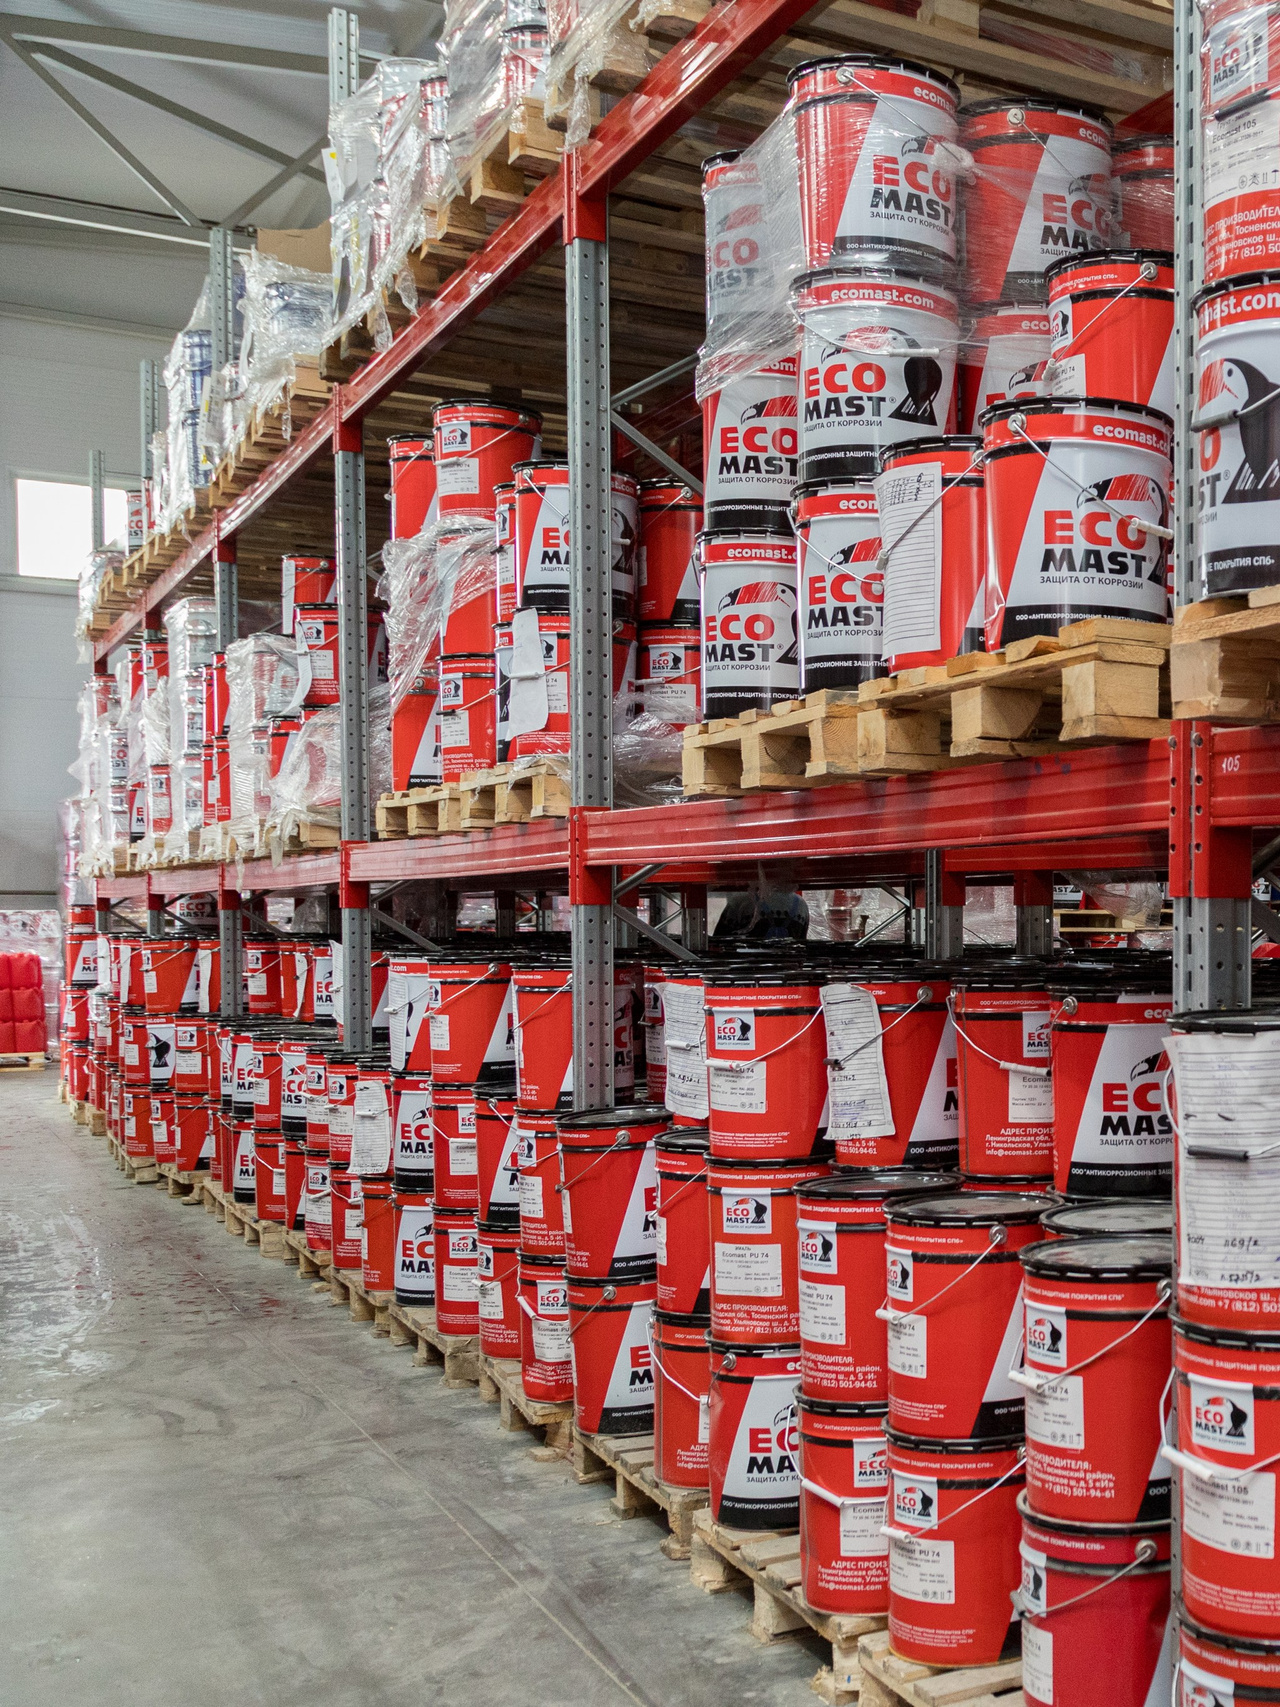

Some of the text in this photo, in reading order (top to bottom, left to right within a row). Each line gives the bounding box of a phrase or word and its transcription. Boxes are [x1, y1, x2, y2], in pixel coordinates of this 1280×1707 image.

[1213, 125, 1241, 144] Ecomast
[1243, 119, 1257, 130] 105
[873, 155, 951, 201] ECO
[870, 188, 952, 228] MAST
[1229, 250, 1239, 260] +7
[1241, 244, 1265, 259] (812)
[831, 287, 933, 309] ecomast.com
[804, 363, 886, 399] ECO
[804, 396, 886, 423] MAST
[720, 426, 798, 453] ECO
[1093, 424, 1171, 451] ecomast.co
[718, 456, 798, 476] MAST
[756, 477, 798, 485] КОРРОЗИИ
[1044, 510, 1147, 550] ECO
[1040, 549, 1147, 578] MAST
[1215, 557, 1251, 571] ПОКРЫТИЯ
[809, 574, 884, 605] ECO
[1040, 576, 1080, 584] ЗАЩИТА
[1099, 577, 1143, 589] КОРРОЗИИ
[705, 614, 774, 642] ECO
[807, 630, 831, 639] ЗАЩИТА
[705, 644, 774, 662] MAST
[1222, 755, 1240, 773] 105
[180, 903, 205, 911] ECO
[1232, 1301, 1259, 1313] (812)
[1215, 1360, 1256, 1371] ЗАЩИТНЫЕ
[839, 1380, 877, 1388] 501-94-61
[1059, 1387, 1069, 1395] 74
[1196, 1406, 1224, 1424] ECO
[1054, 1485, 1115, 1498] (812) 501-94-61
[1233, 1485, 1248, 1495] 105
[919, 1550, 930, 1558] PU
[831, 1560, 854, 1568] АДРЕС
